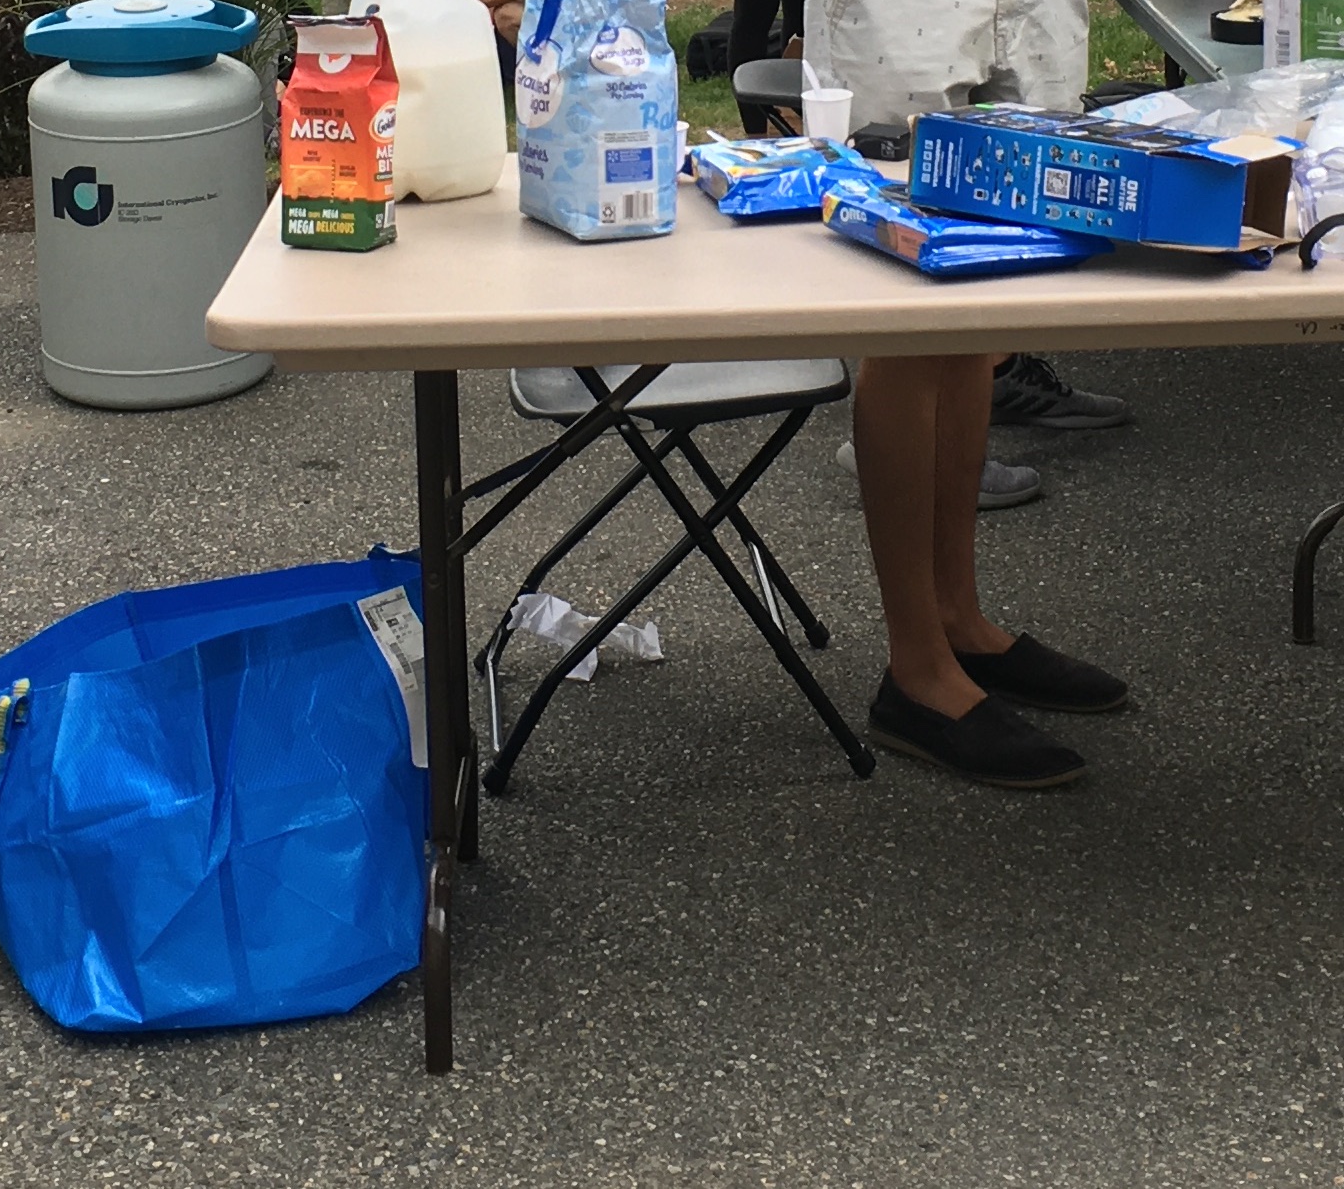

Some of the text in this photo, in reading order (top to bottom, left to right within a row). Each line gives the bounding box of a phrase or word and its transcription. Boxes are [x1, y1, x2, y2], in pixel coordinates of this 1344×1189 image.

[290, 118, 355, 141] MEGA
[1096, 176, 1109, 205] ALL
[1118, 175, 1127, 212] BATTERY
[1125, 179, 1138, 212] ONE
[289, 208, 307, 218] MEGA
[322, 209, 339, 219] MEGA
[288, 219, 355, 235] MEGA DELICIOUS
